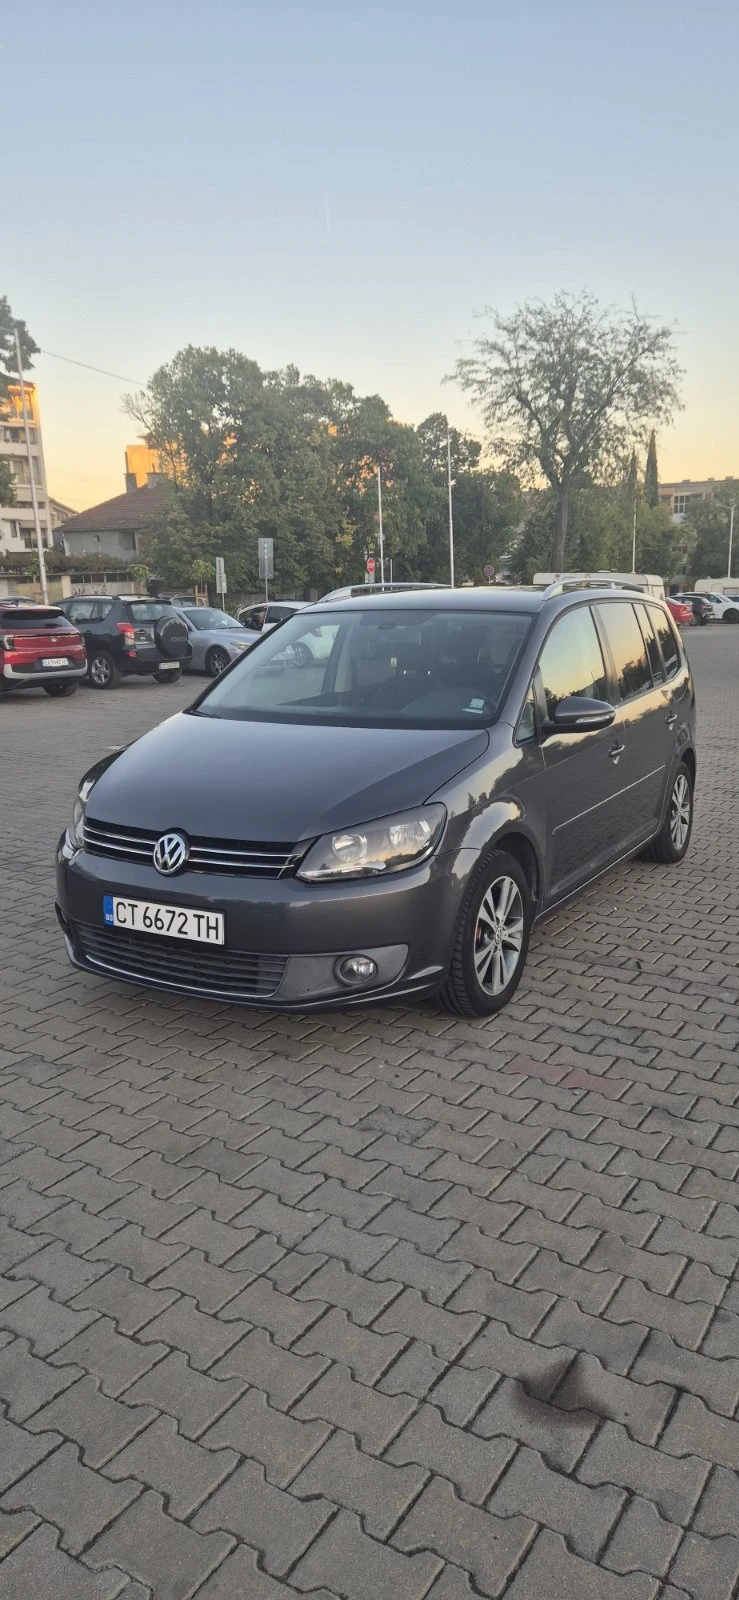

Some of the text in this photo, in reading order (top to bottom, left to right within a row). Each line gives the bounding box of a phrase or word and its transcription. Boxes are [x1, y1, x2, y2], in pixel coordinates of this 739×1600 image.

[153, 834, 187, 873] VW
[115, 902, 138, 926] CT
[142, 906, 189, 935] 6672
[192, 914, 219, 940] TH
